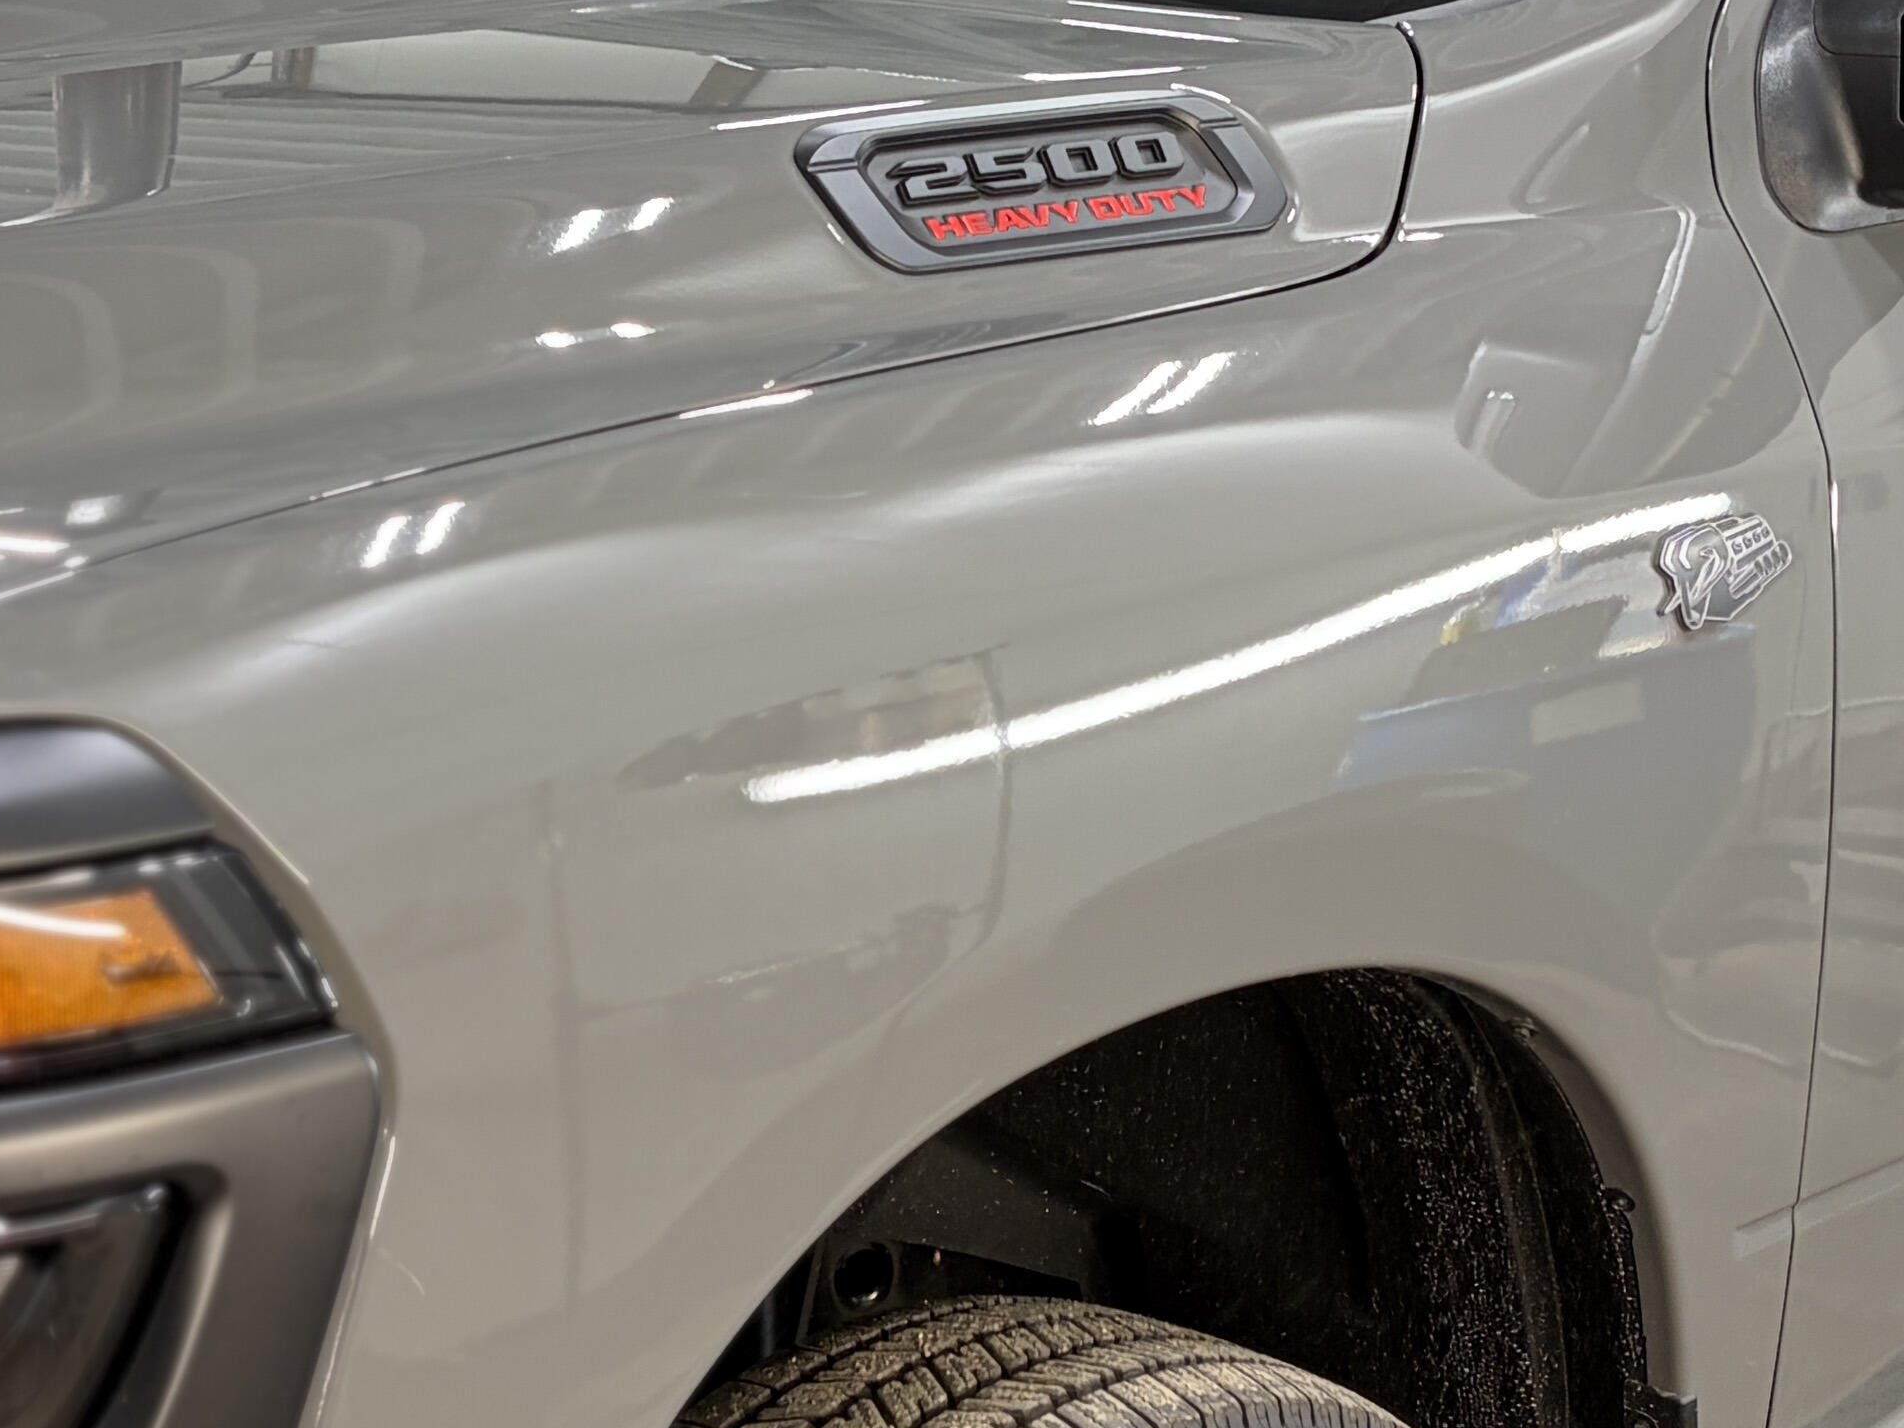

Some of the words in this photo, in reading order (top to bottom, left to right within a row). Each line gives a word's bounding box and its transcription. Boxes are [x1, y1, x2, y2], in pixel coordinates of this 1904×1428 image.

[887, 133, 1184, 206] 2500
[925, 201, 1079, 241] HEAVY
[1091, 185, 1208, 219] DUTY
